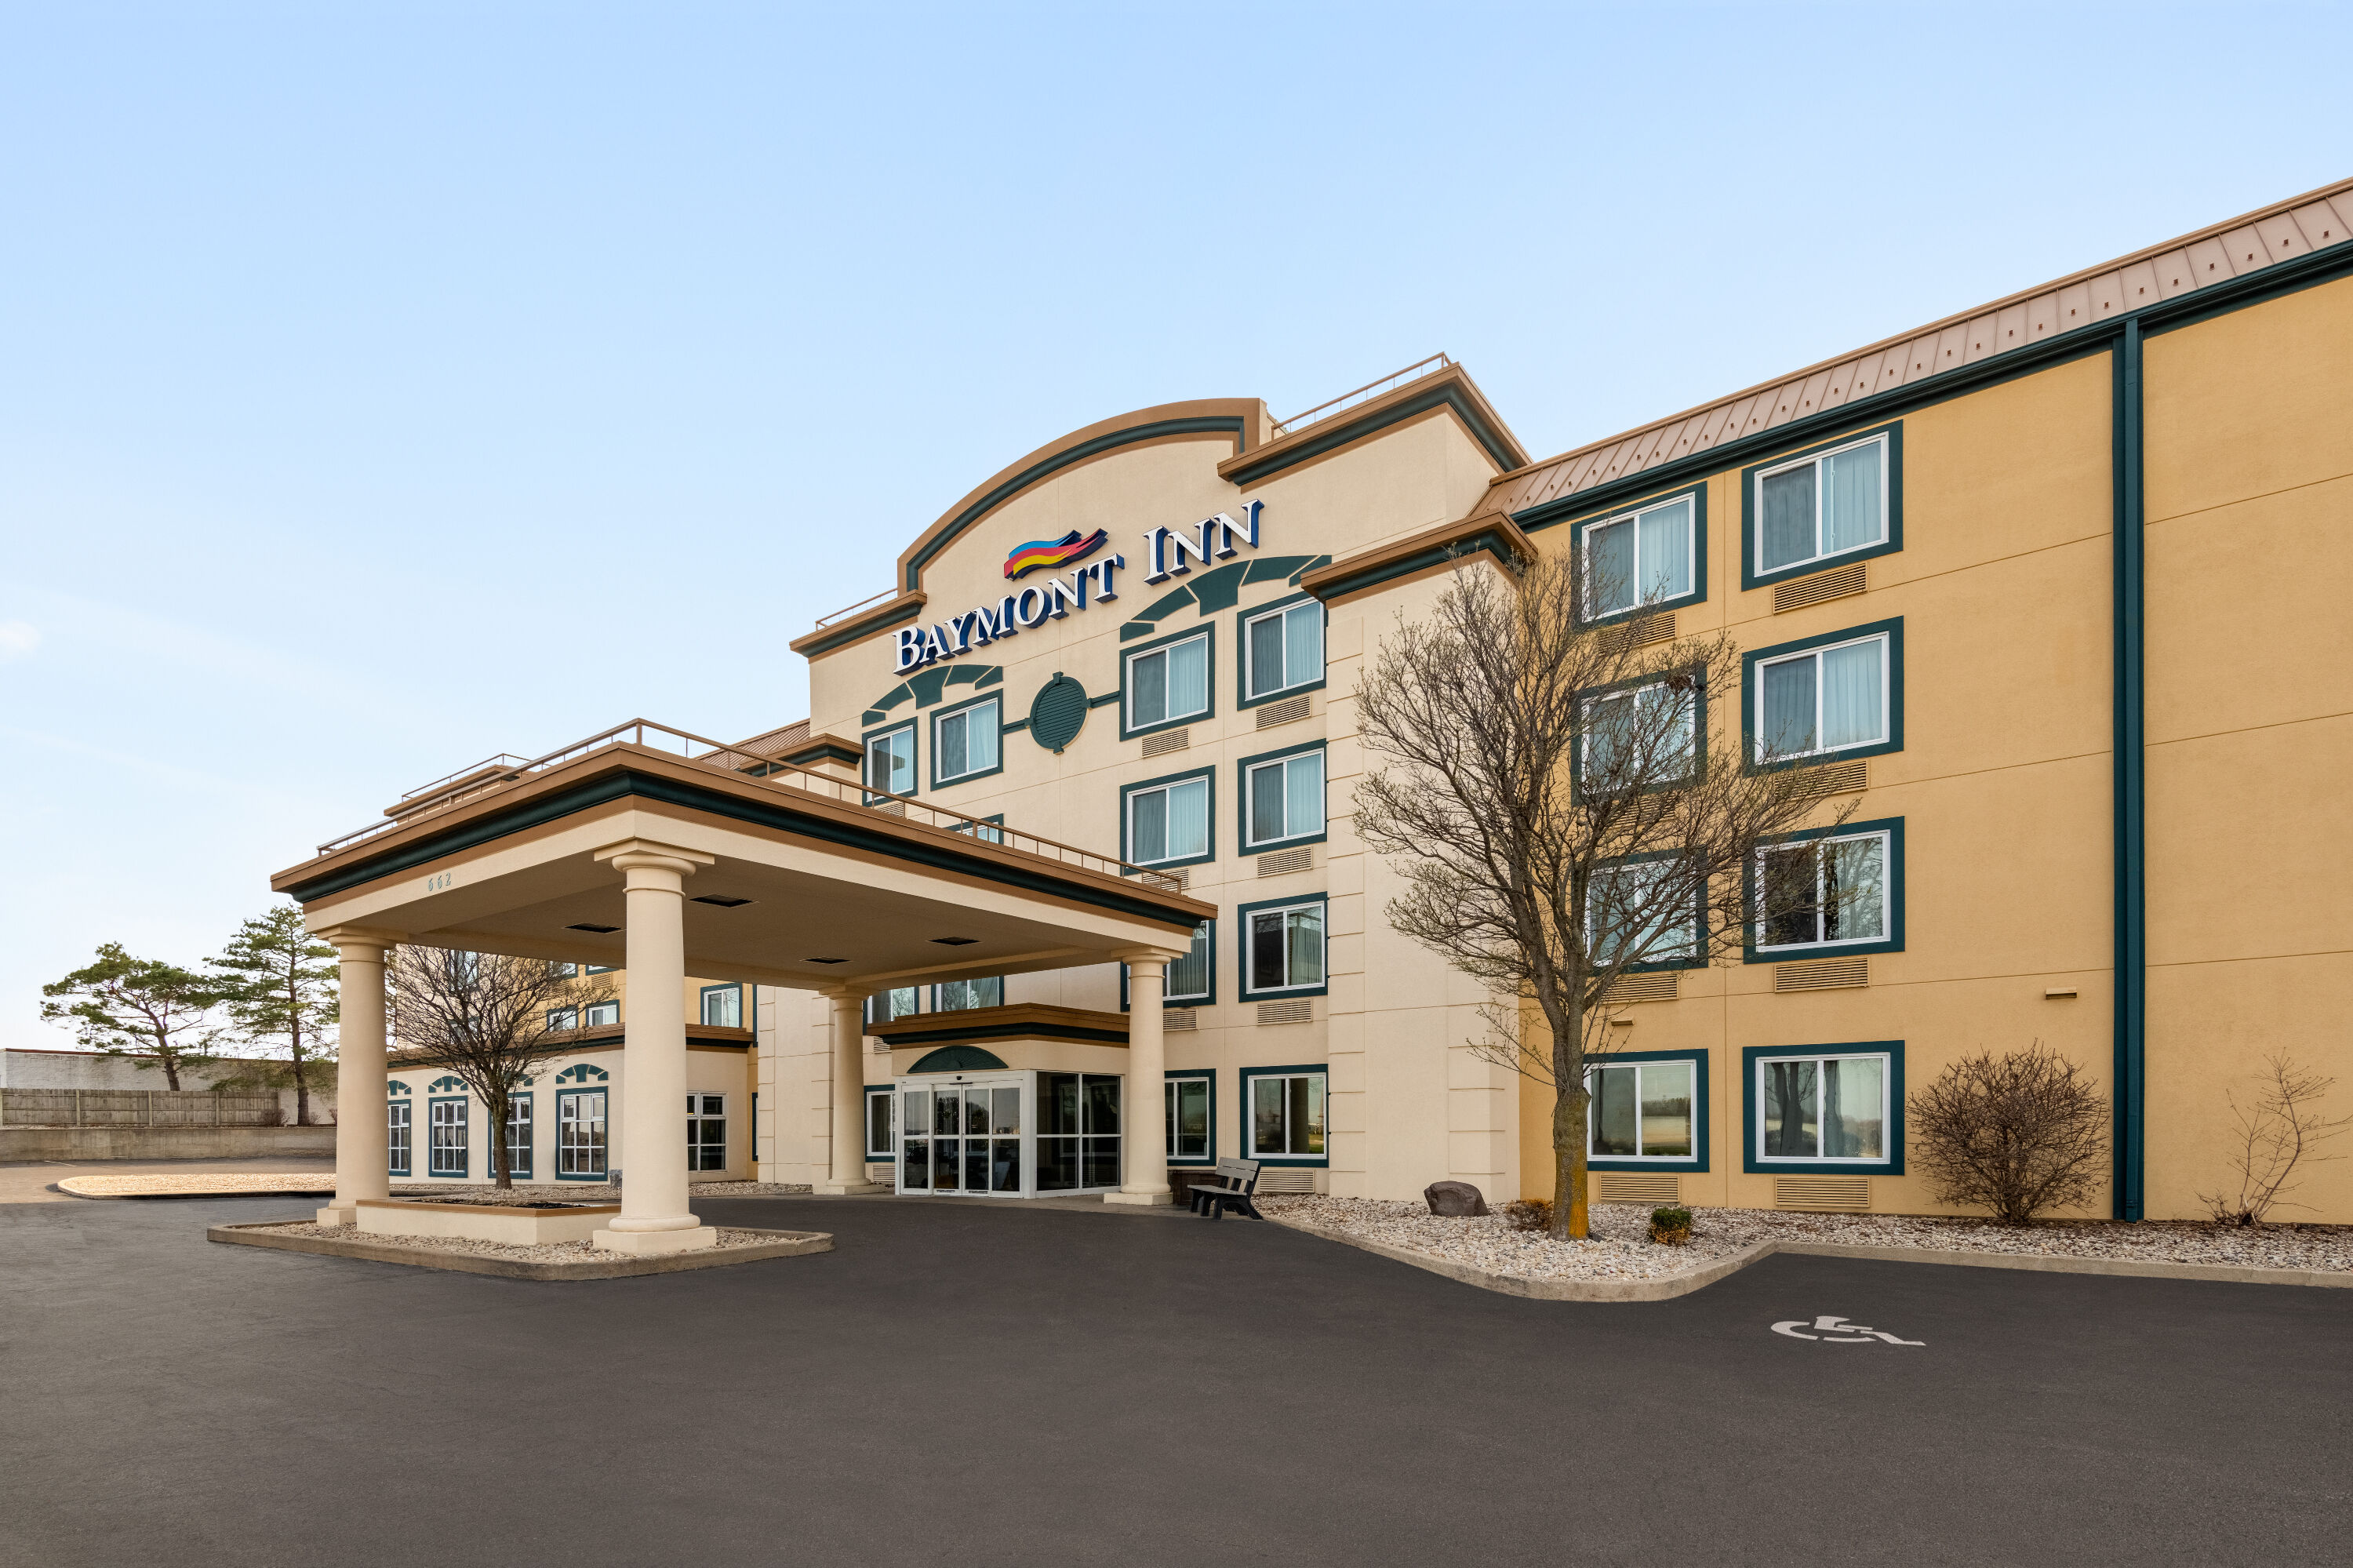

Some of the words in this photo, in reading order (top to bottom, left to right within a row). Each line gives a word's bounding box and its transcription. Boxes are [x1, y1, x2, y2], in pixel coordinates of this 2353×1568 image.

[893, 553, 1125, 676] BAYMONT
[1143, 499, 1264, 586] INN
[428, 872, 451, 891] 662
